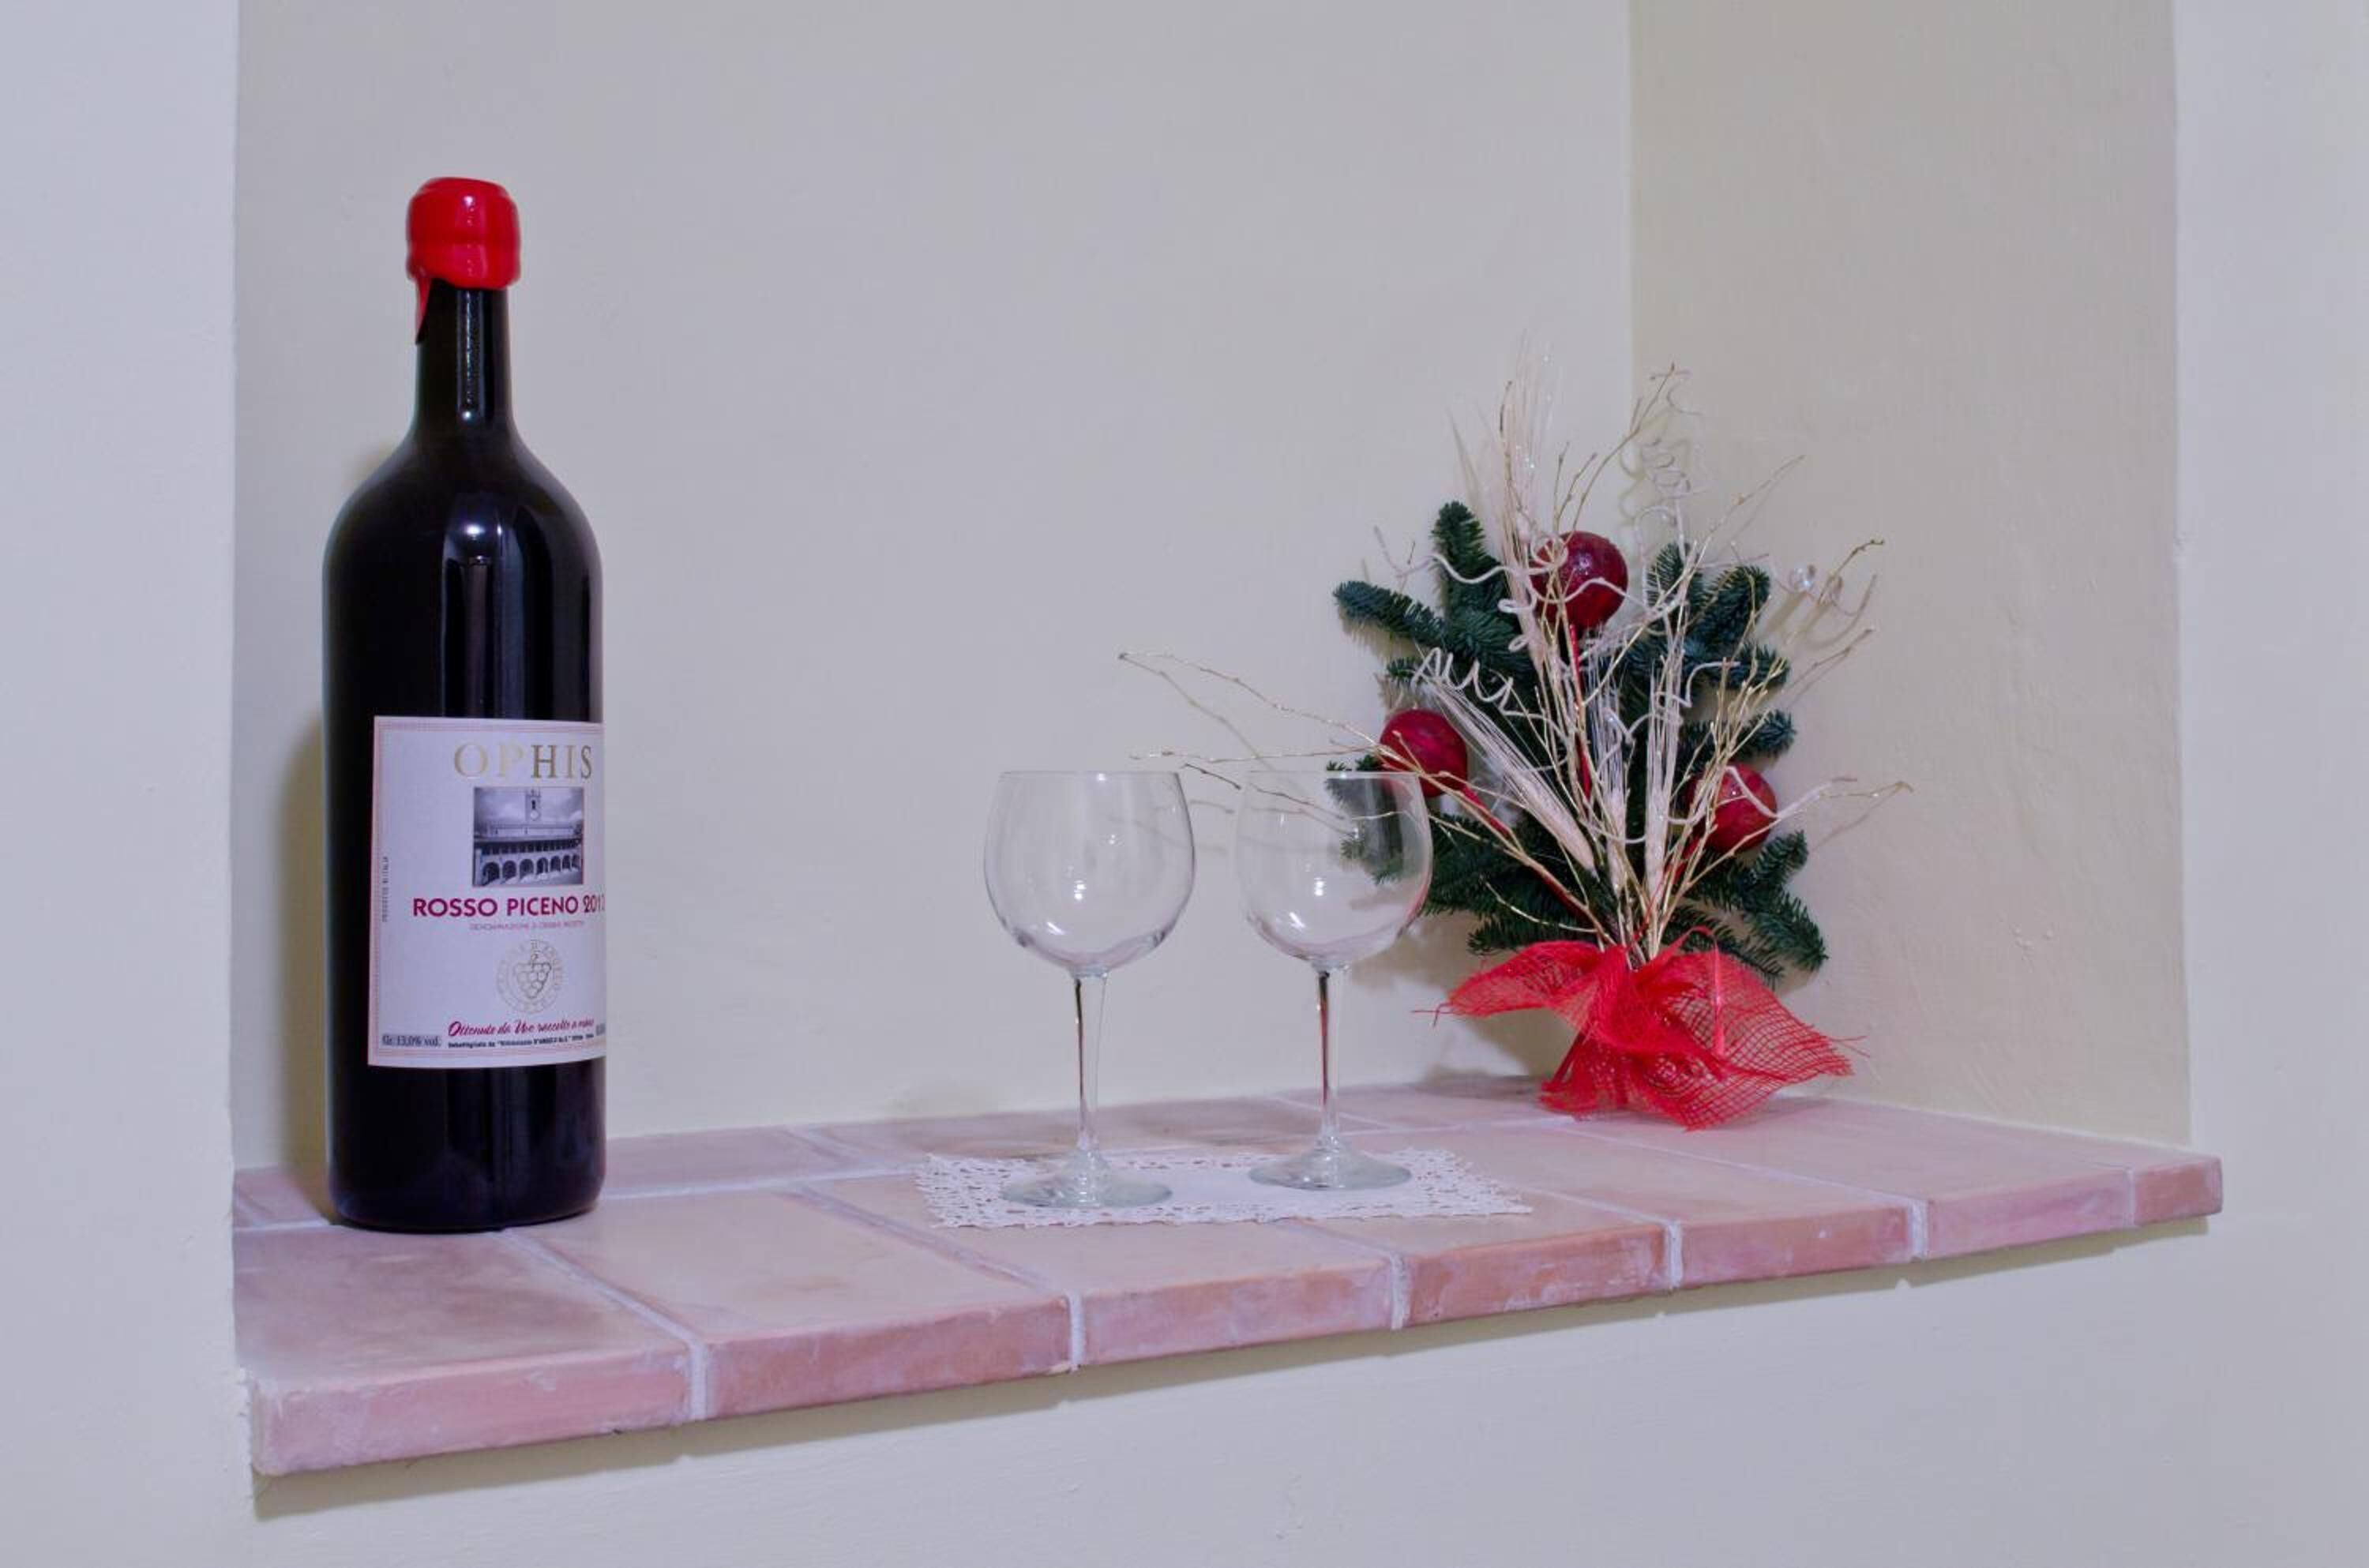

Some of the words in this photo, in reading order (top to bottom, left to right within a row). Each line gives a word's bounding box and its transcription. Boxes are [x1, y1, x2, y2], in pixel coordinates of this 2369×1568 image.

[454, 742, 592, 780] OPHIS
[412, 897, 498, 917] ROSSO
[506, 895, 579, 916] PICENO
